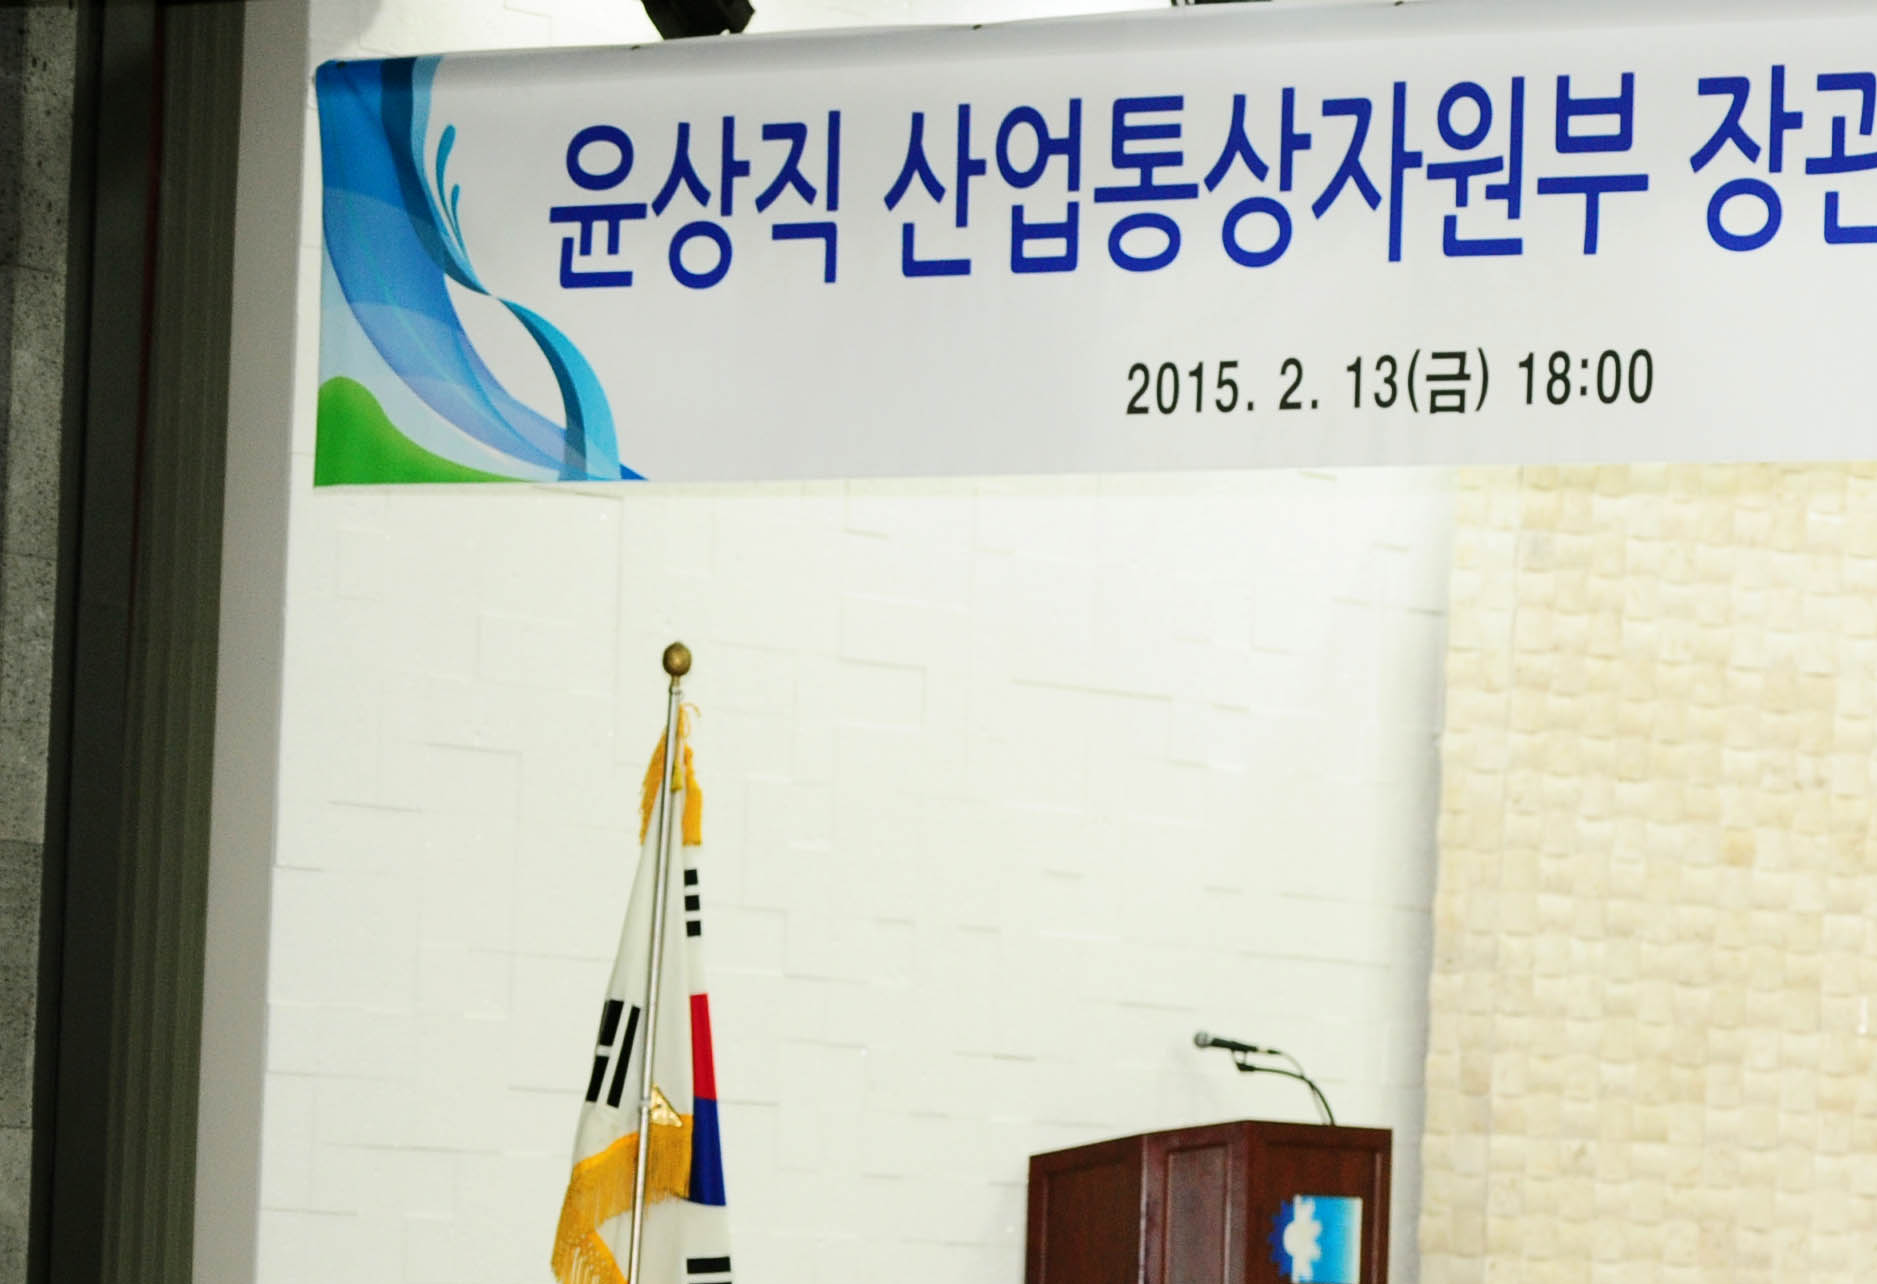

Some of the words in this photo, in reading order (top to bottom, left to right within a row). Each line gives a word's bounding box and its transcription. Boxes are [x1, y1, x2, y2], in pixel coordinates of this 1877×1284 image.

[550, 111, 840, 289] 윤상직
[884, 72, 1648, 277] 산업통상자원부
[1126, 360, 1254, 415] 2015.
[1279, 357, 1318, 410] 2.
[1346, 347, 1489, 415] 13(금)
[1518, 348, 1654, 405] 18:00
